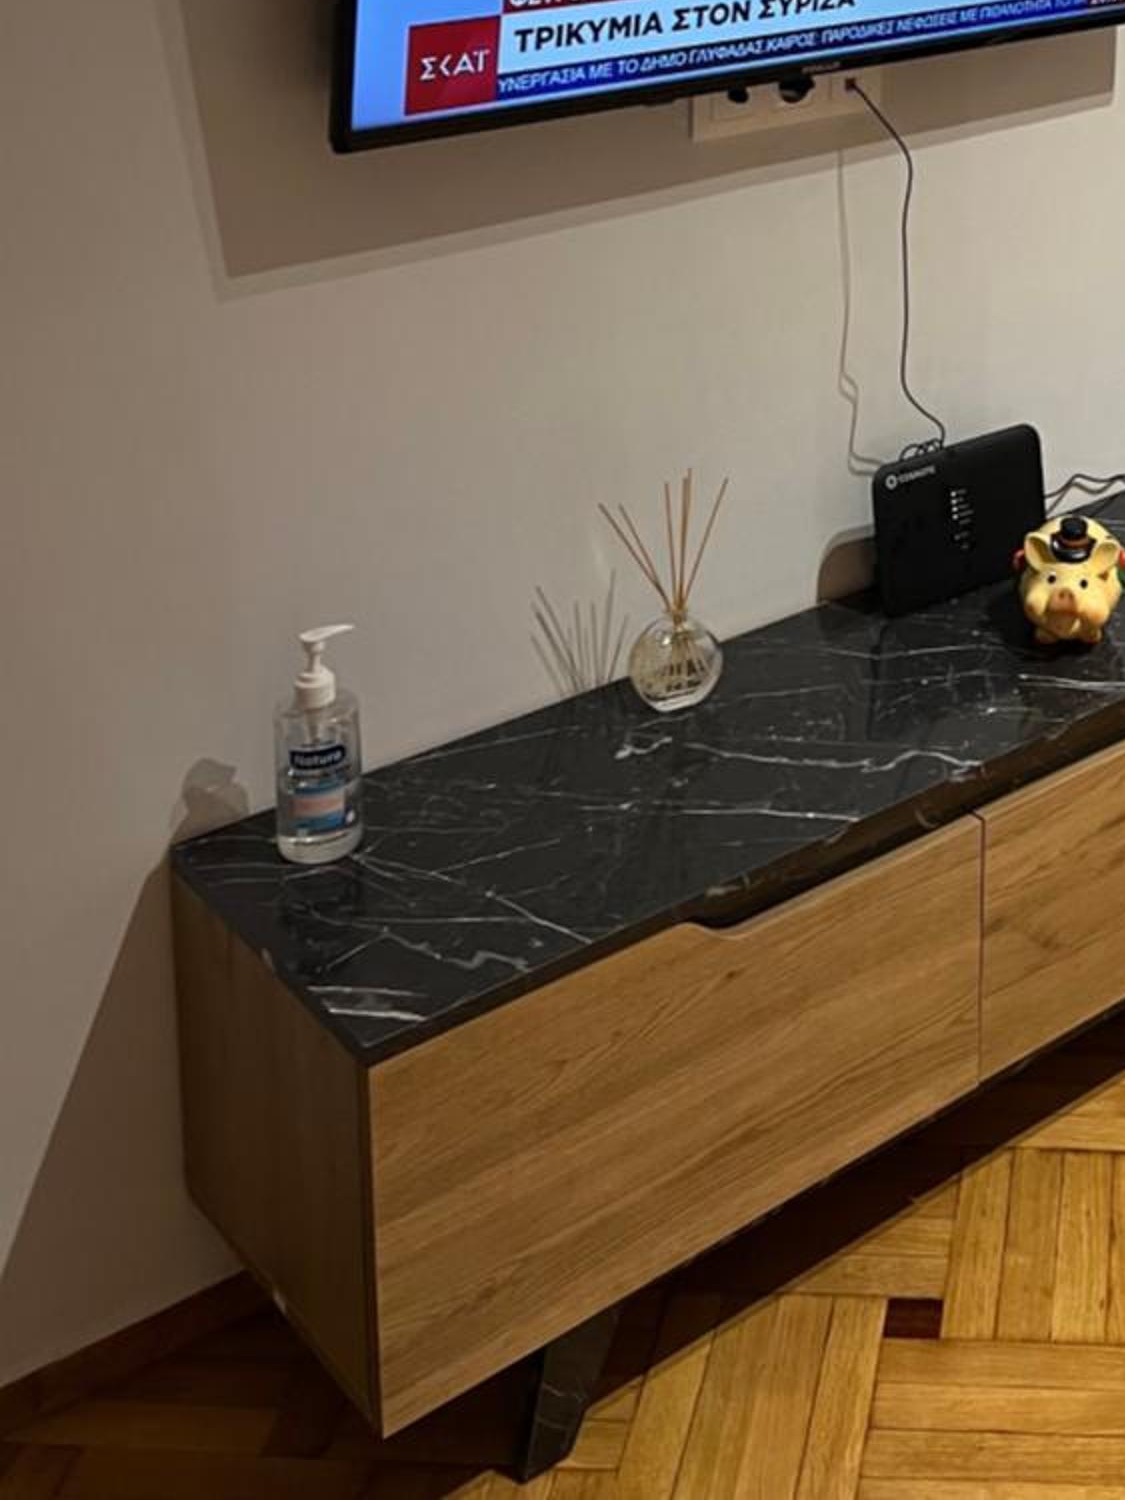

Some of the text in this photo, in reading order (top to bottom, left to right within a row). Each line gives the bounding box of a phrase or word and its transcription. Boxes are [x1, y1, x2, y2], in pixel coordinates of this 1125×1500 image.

[514, 12, 663, 53] ΤΡΙΚΥΜΙΑ
[671, 0, 751, 31] ΣΤΟΝ
[588, 62, 613, 80] ΜΕ
[618, 59, 638, 74] ΤΟ
[640, 52, 687, 72] ΔΗΜΟ
[959, 8, 978, 23] ΜΕ
